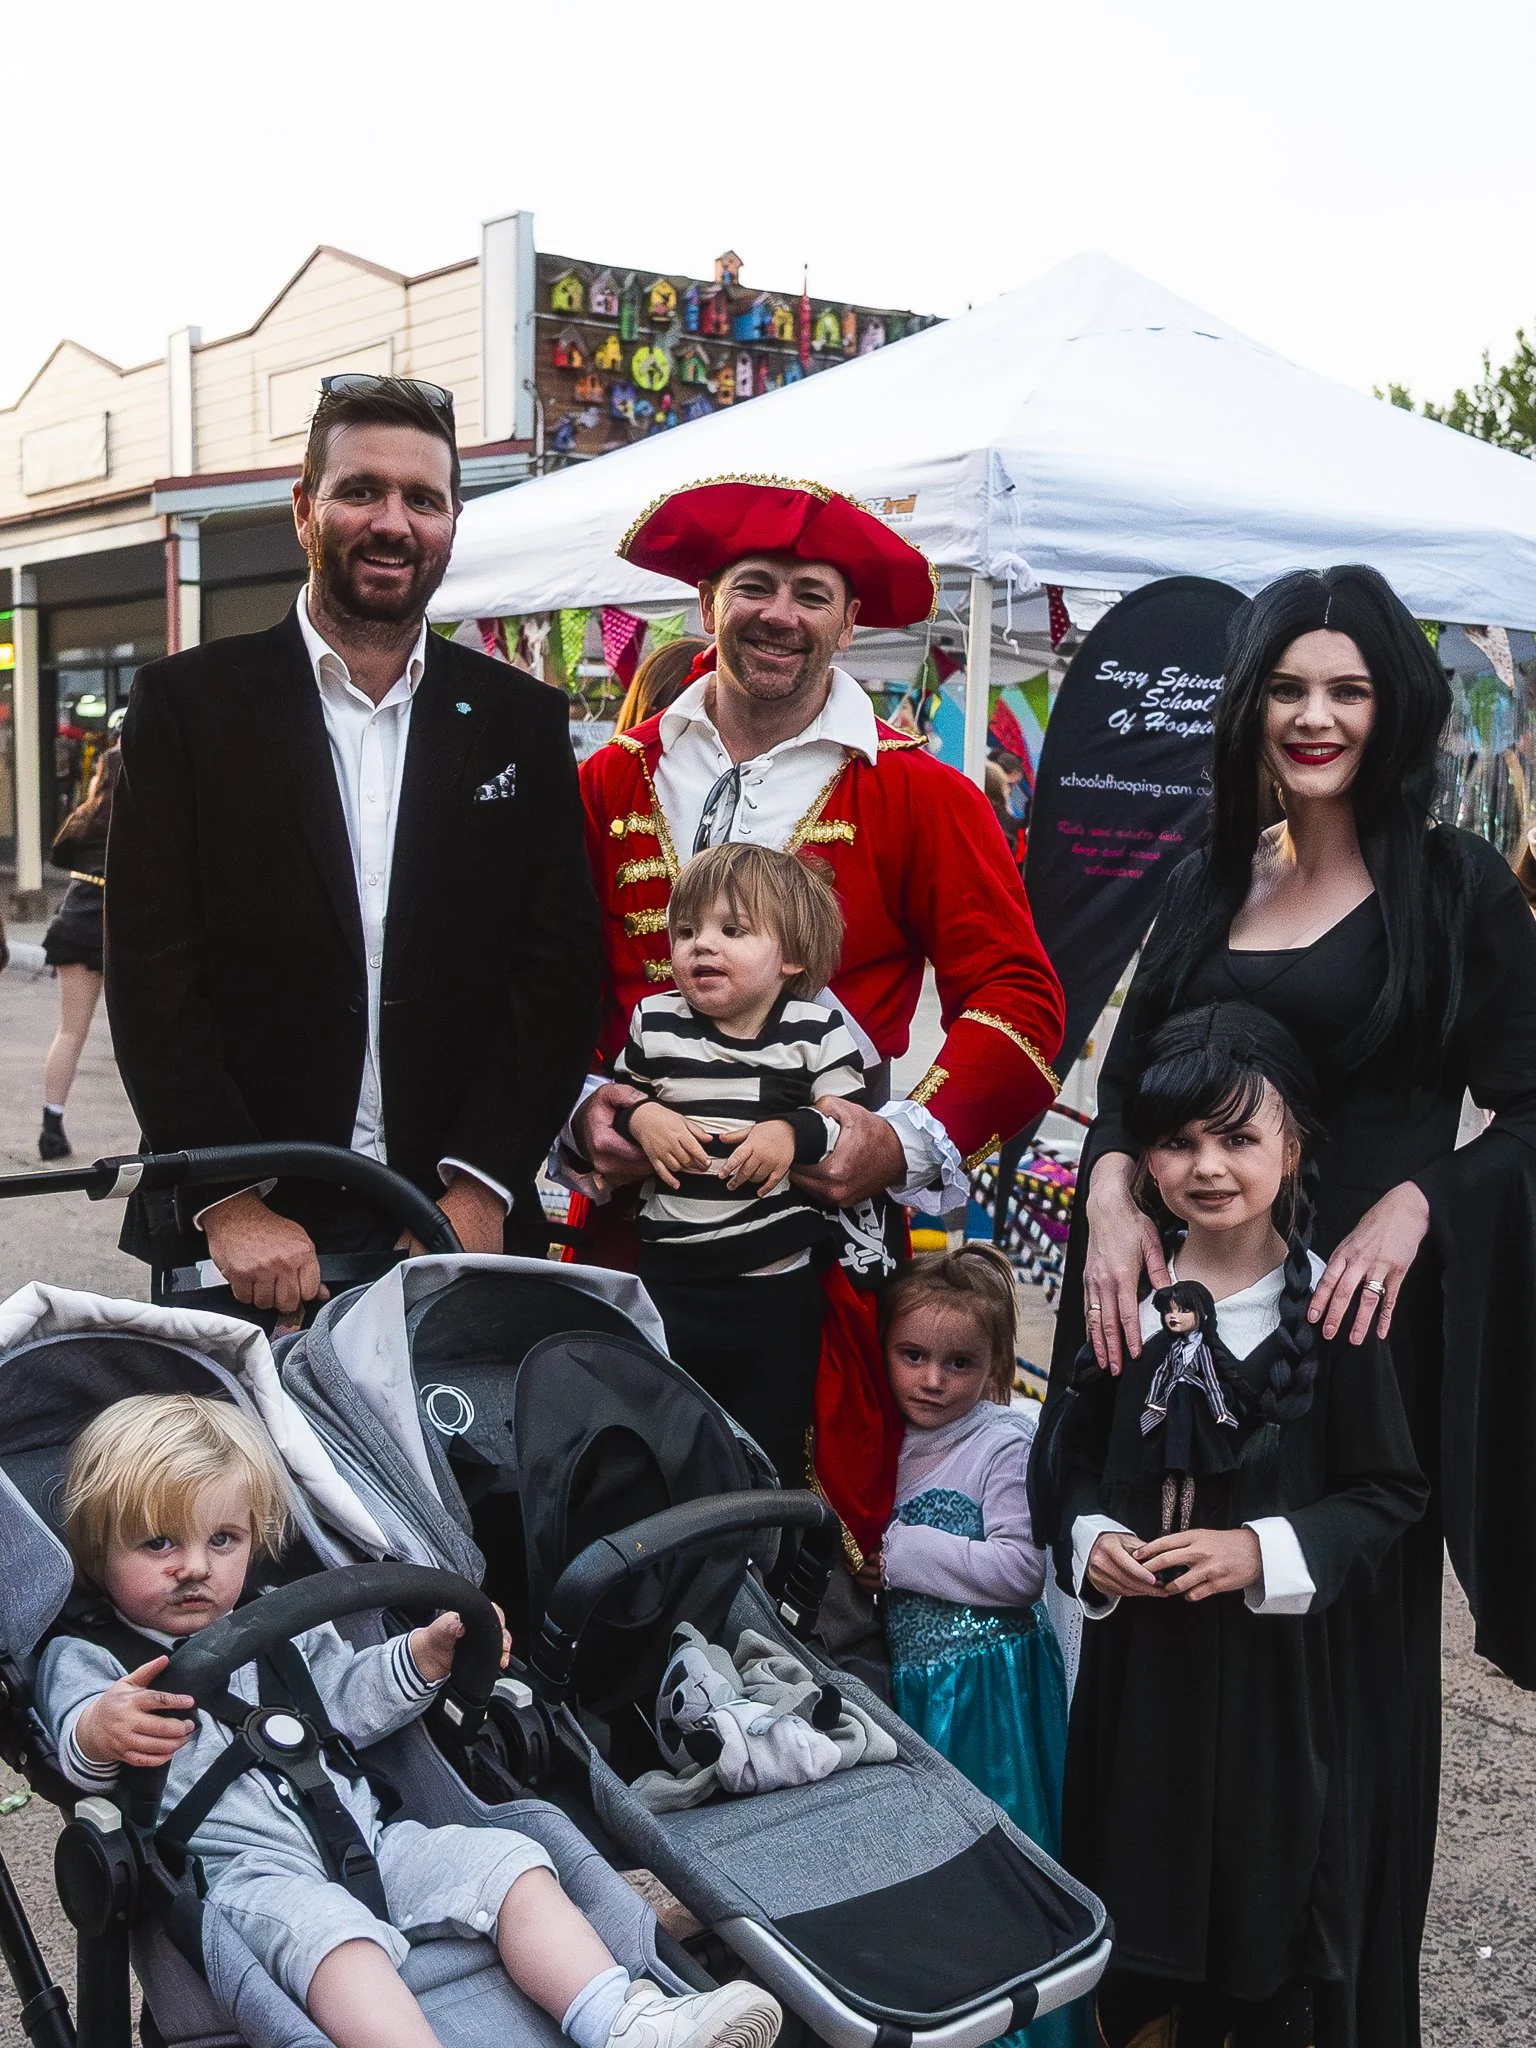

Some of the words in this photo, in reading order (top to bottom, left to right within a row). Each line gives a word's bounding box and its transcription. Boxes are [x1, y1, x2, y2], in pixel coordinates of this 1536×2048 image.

[1095, 660, 1149, 689] Suzy
[1156, 666, 1225, 692] Spind
[1140, 687, 1216, 712] School
[1108, 709, 1137, 735] Of
[1144, 711, 1216, 738] Hoopin
